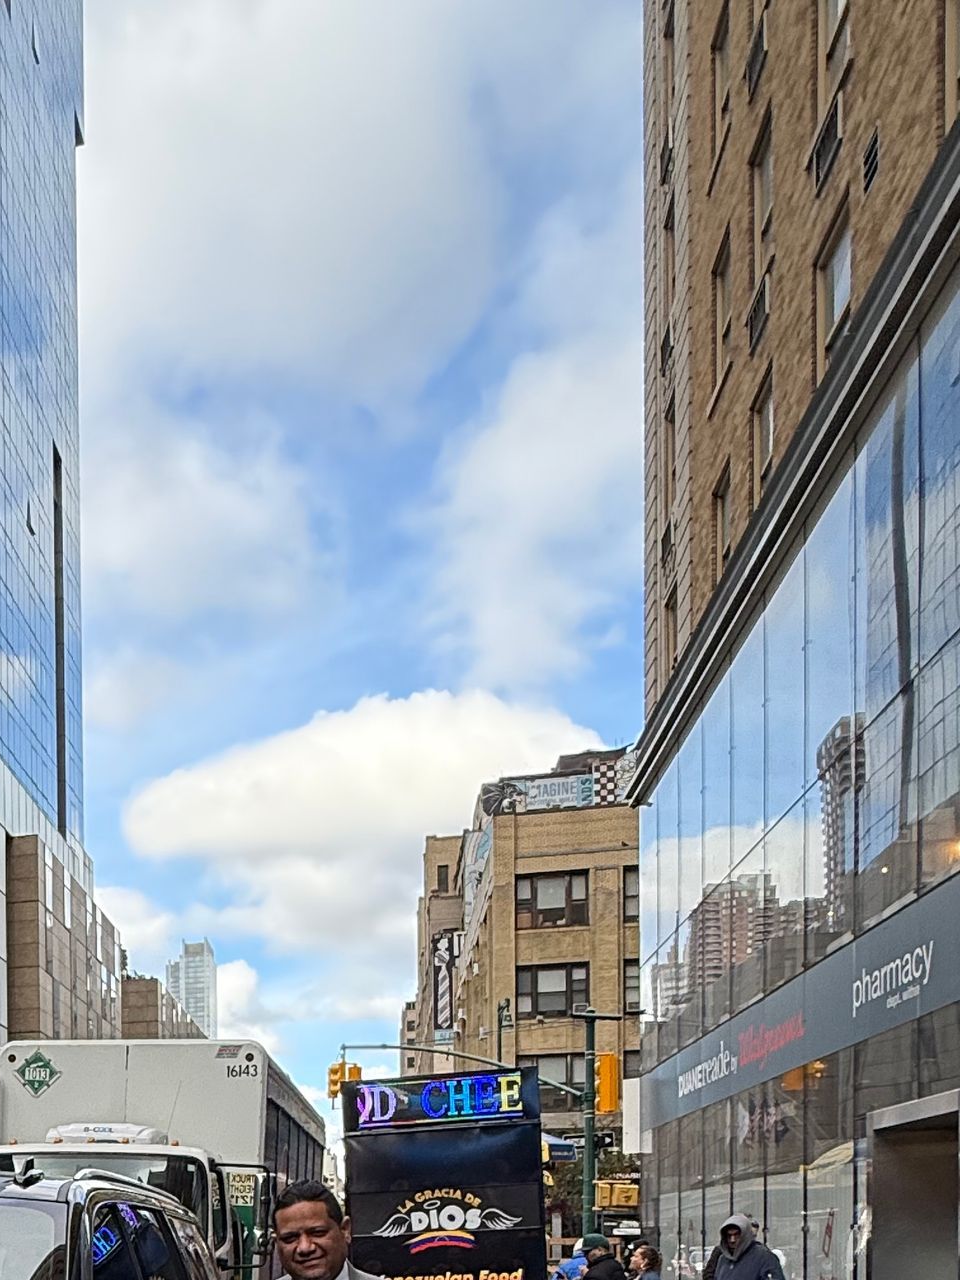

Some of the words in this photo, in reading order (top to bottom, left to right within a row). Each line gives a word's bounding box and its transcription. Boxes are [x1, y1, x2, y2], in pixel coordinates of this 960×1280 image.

[852, 940, 934, 1018] pharmacy
[738, 1009, 806, 1071] Walgreens
[25, 1067, 49, 1080] 1013
[226, 1064, 258, 1078] 16143
[397, 1199, 415, 1214] LA
[414, 1187, 463, 1203] GRACIA
[464, 1193, 482, 1208] DE
[410, 1204, 482, 1232] DIOS
